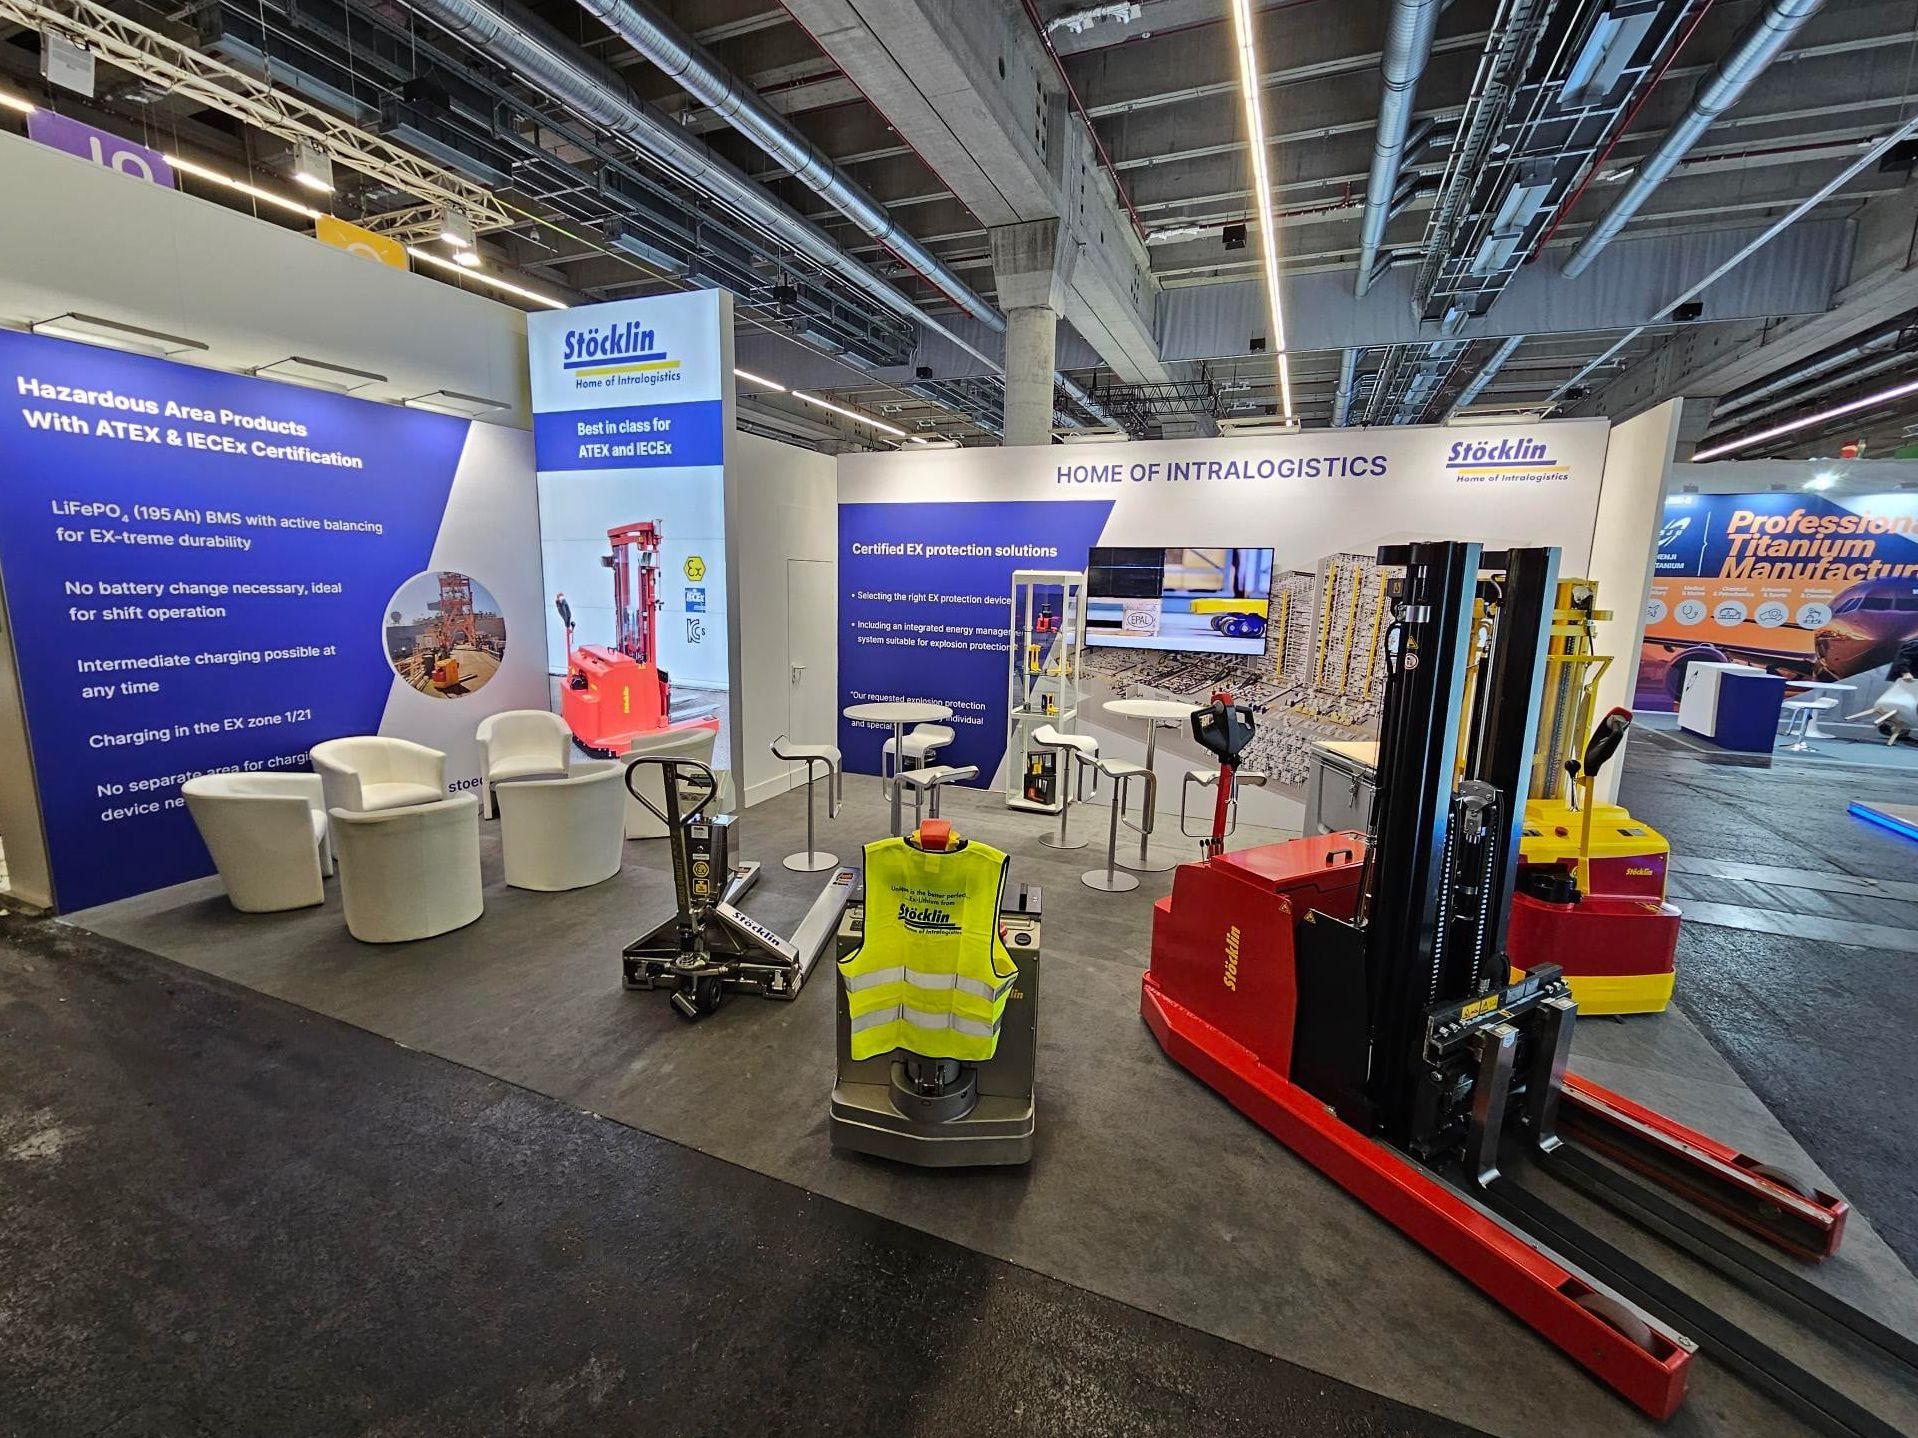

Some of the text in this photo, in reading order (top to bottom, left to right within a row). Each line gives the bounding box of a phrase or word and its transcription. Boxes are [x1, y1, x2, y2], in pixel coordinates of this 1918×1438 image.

[564, 320, 655, 360] Stöcklin
[576, 371, 681, 388] Home of Intralogistics
[17, 376, 308, 437] Hazardous Area Products
[578, 417, 671, 436] Best in class for
[23, 409, 363, 469] With ATEX & IECEx Certification
[579, 441, 672, 459] ATEX and IECEx
[1448, 438, 1547, 462] Stöcklin
[1056, 454, 1388, 484] HOME OF INTRALOGISTICS
[1456, 475, 1485, 483] Home
[1502, 473, 1568, 482] Intralogistics
[206, 512, 242, 527] BMS
[246, 514, 278, 528] with
[280, 518, 320, 530] active
[324, 518, 384, 536] balancing
[56, 526, 252, 552] for EX-treme durability
[1728, 533, 1876, 558] Titanium
[852, 542, 1058, 559] Certified EX protection solutions
[66, 580, 342, 598] No battery change necessary, ideal
[858, 591, 892, 602] Selecting
[894, 592, 906, 602] the
[908, 593, 927, 604] right
[928, 594, 938, 602] EX
[940, 594, 982, 605] protection
[69, 604, 226, 622] for shift operation
[1131, 616, 1149, 625] EPAL
[858, 620, 891, 632] Including
[904, 622, 944, 633] integrated
[946, 625, 974, 636] energy
[858, 635, 884, 645] system
[886, 636, 915, 646] suitable
[918, 638, 928, 646] for
[930, 638, 968, 650] explosion
[78, 645, 336, 673] Intermediate charging possible at
[82, 680, 160, 700] any time
[868, 693, 904, 702] requested
[945, 700, 986, 710] protection
[89, 708, 312, 749] Charging in the EX zone 1/21
[852, 720, 864, 728] and
[947, 714, 984, 725] individual
[98, 784, 124, 798] No
[244, 760, 264, 772] for
[268, 750, 312, 769] chargi
[102, 797, 184, 822] device ne
[899, 903, 950, 922] Stöcklin
[732, 912, 780, 947] Stöcklin
[1223, 925, 1241, 992] Stöcklin
[1010, 988, 1024, 1000] lin
